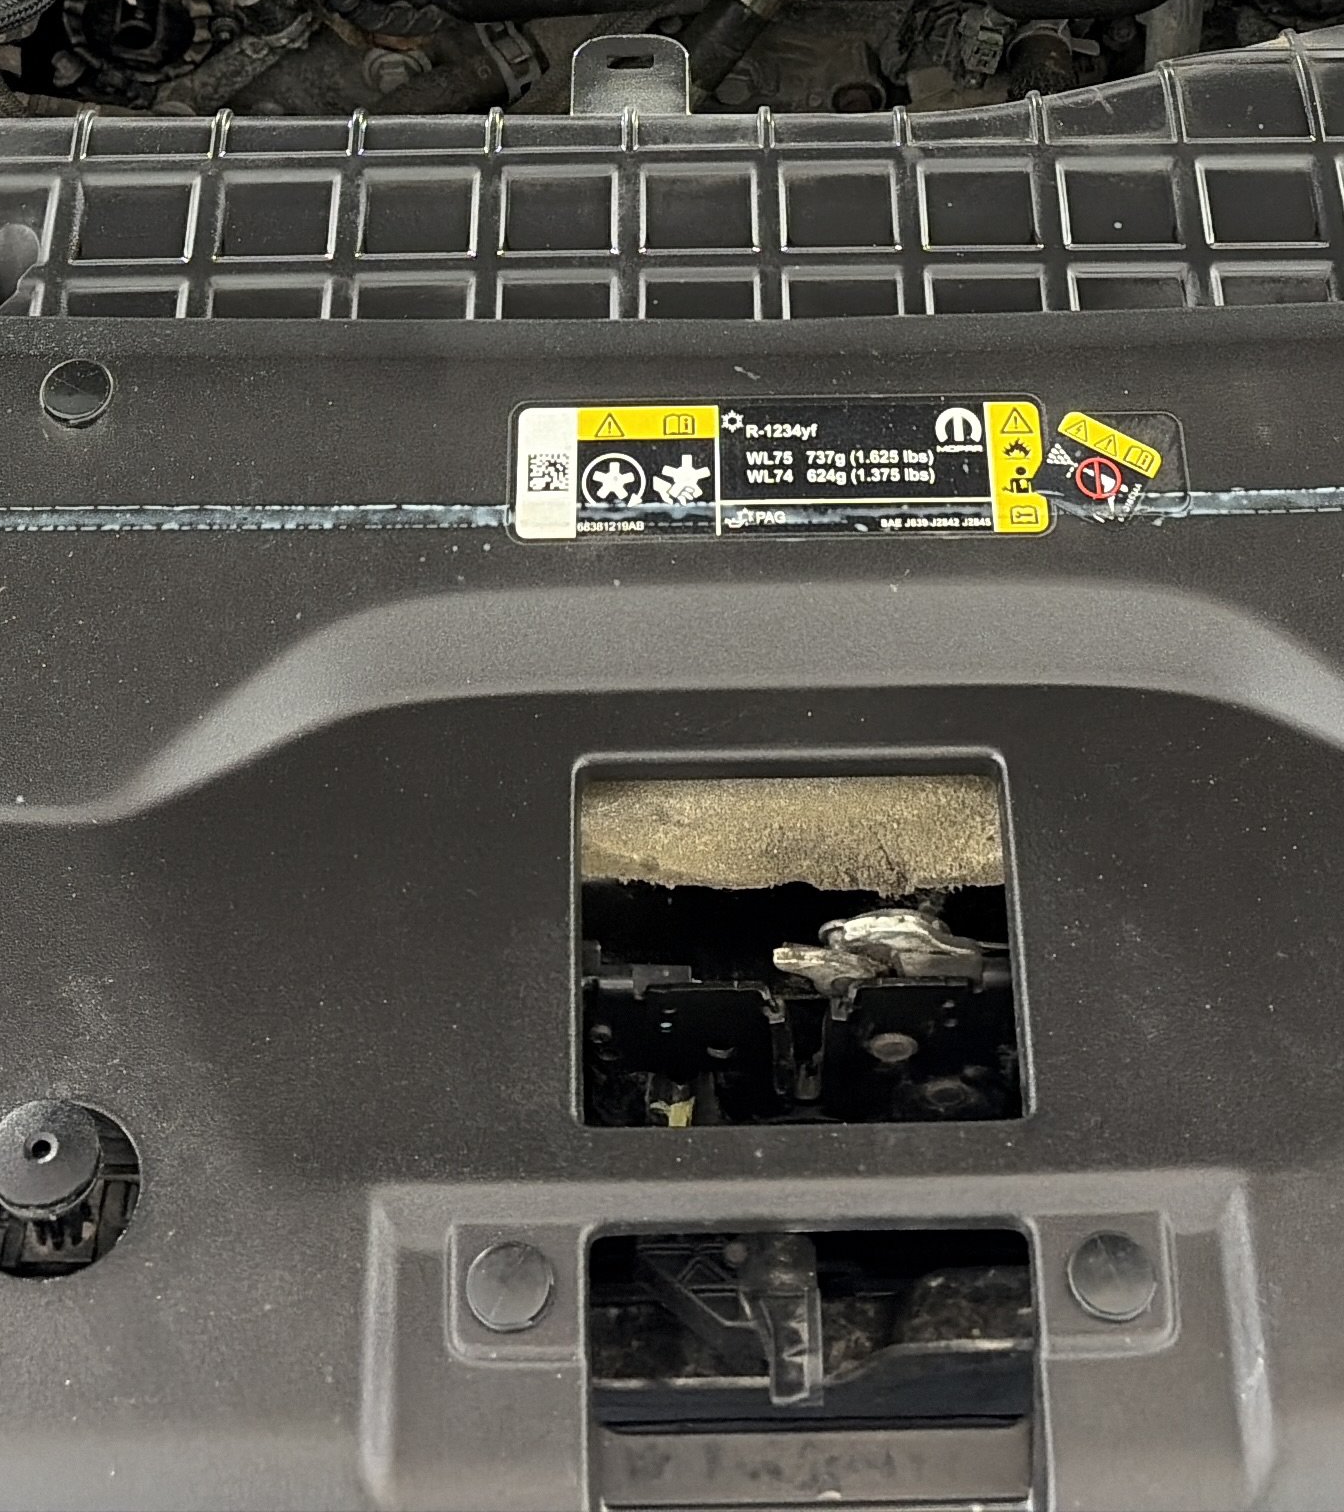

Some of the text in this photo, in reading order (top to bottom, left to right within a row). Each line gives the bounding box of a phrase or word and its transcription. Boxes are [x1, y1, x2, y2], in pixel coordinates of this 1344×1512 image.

[745, 423, 818, 440] R-1234yf
[936, 444, 984, 453] MOPAR
[746, 449, 935, 468] WL75 737g (1.625 lbs)
[747, 467, 936, 486] WL74 624g (1.375 lbs)
[755, 510, 787, 524] PAG
